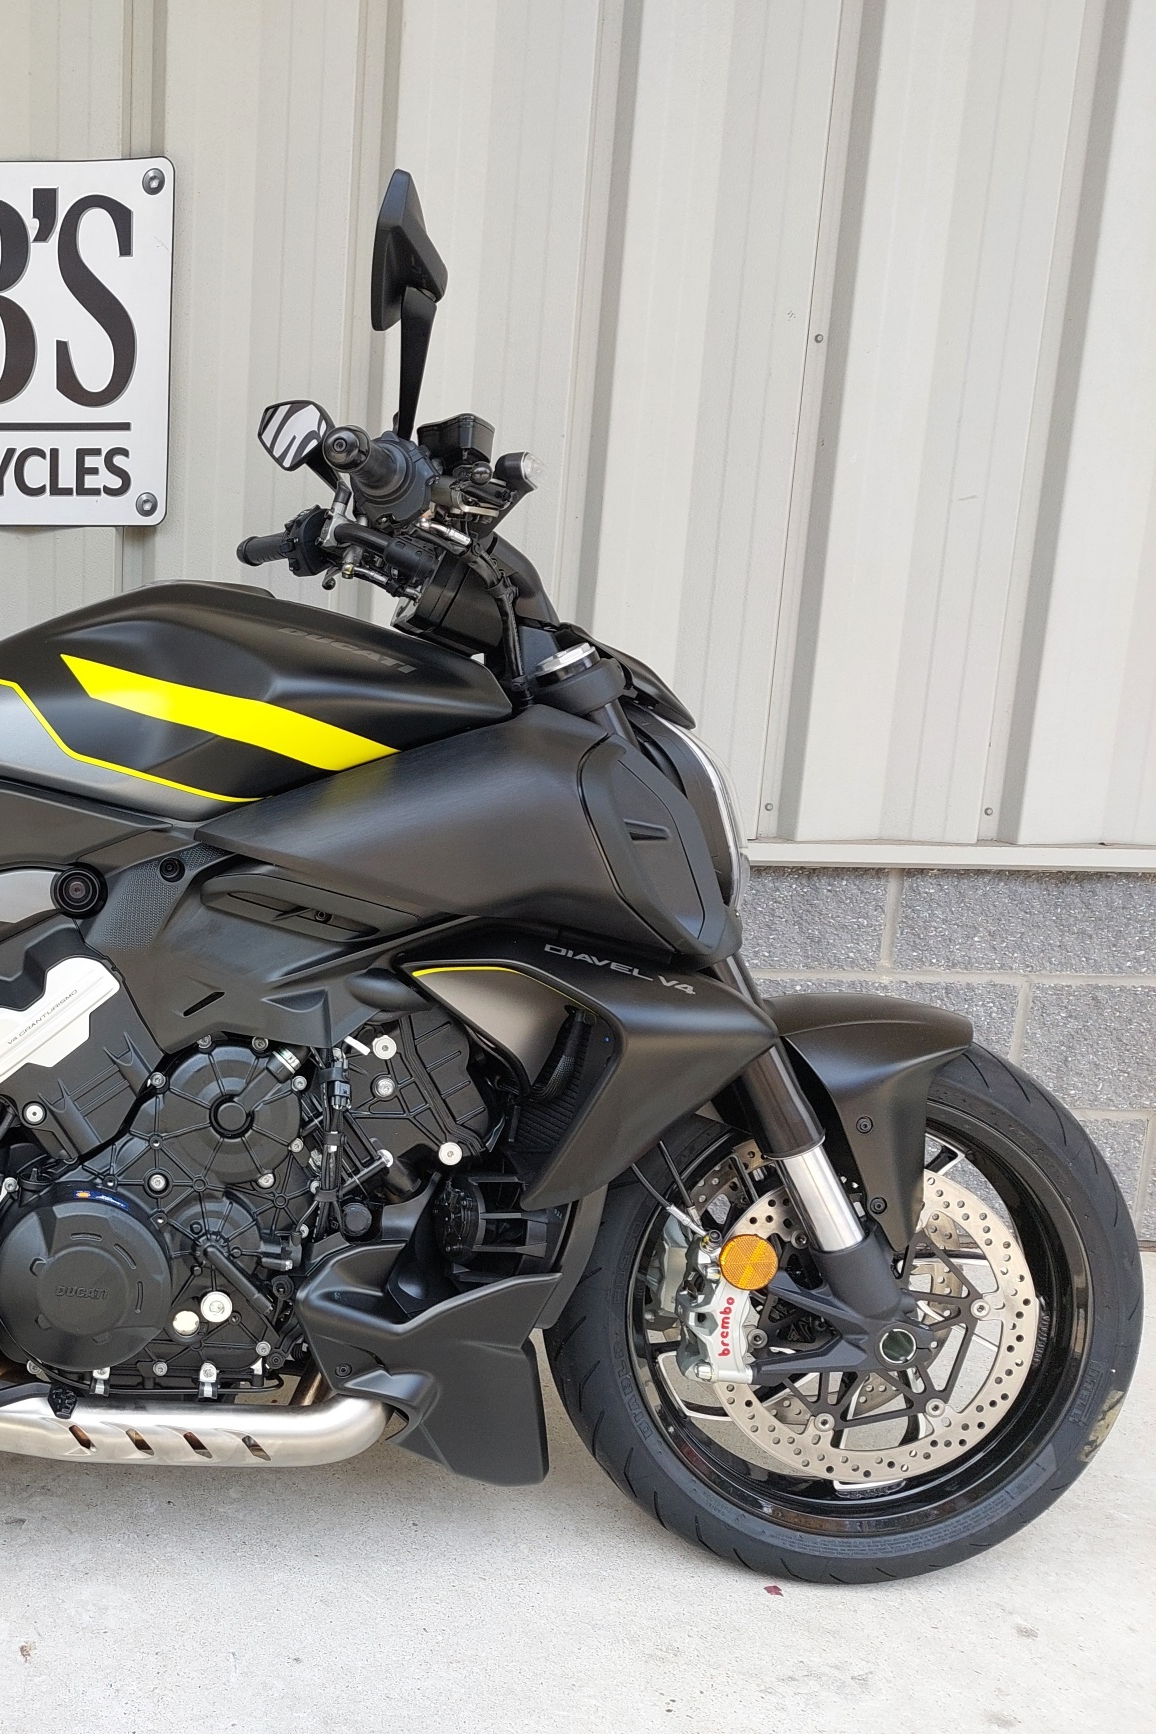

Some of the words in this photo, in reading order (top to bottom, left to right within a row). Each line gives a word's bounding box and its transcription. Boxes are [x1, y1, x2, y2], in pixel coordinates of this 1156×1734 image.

[277, 627, 417, 674] DUCATI
[544, 943, 654, 982] DIAVEL
[658, 975, 696, 995] V4
[18, 989, 78, 1037] GRANTURISMO
[55, 1285, 109, 1300] DUCATI
[718, 1296, 735, 1357] brembo
